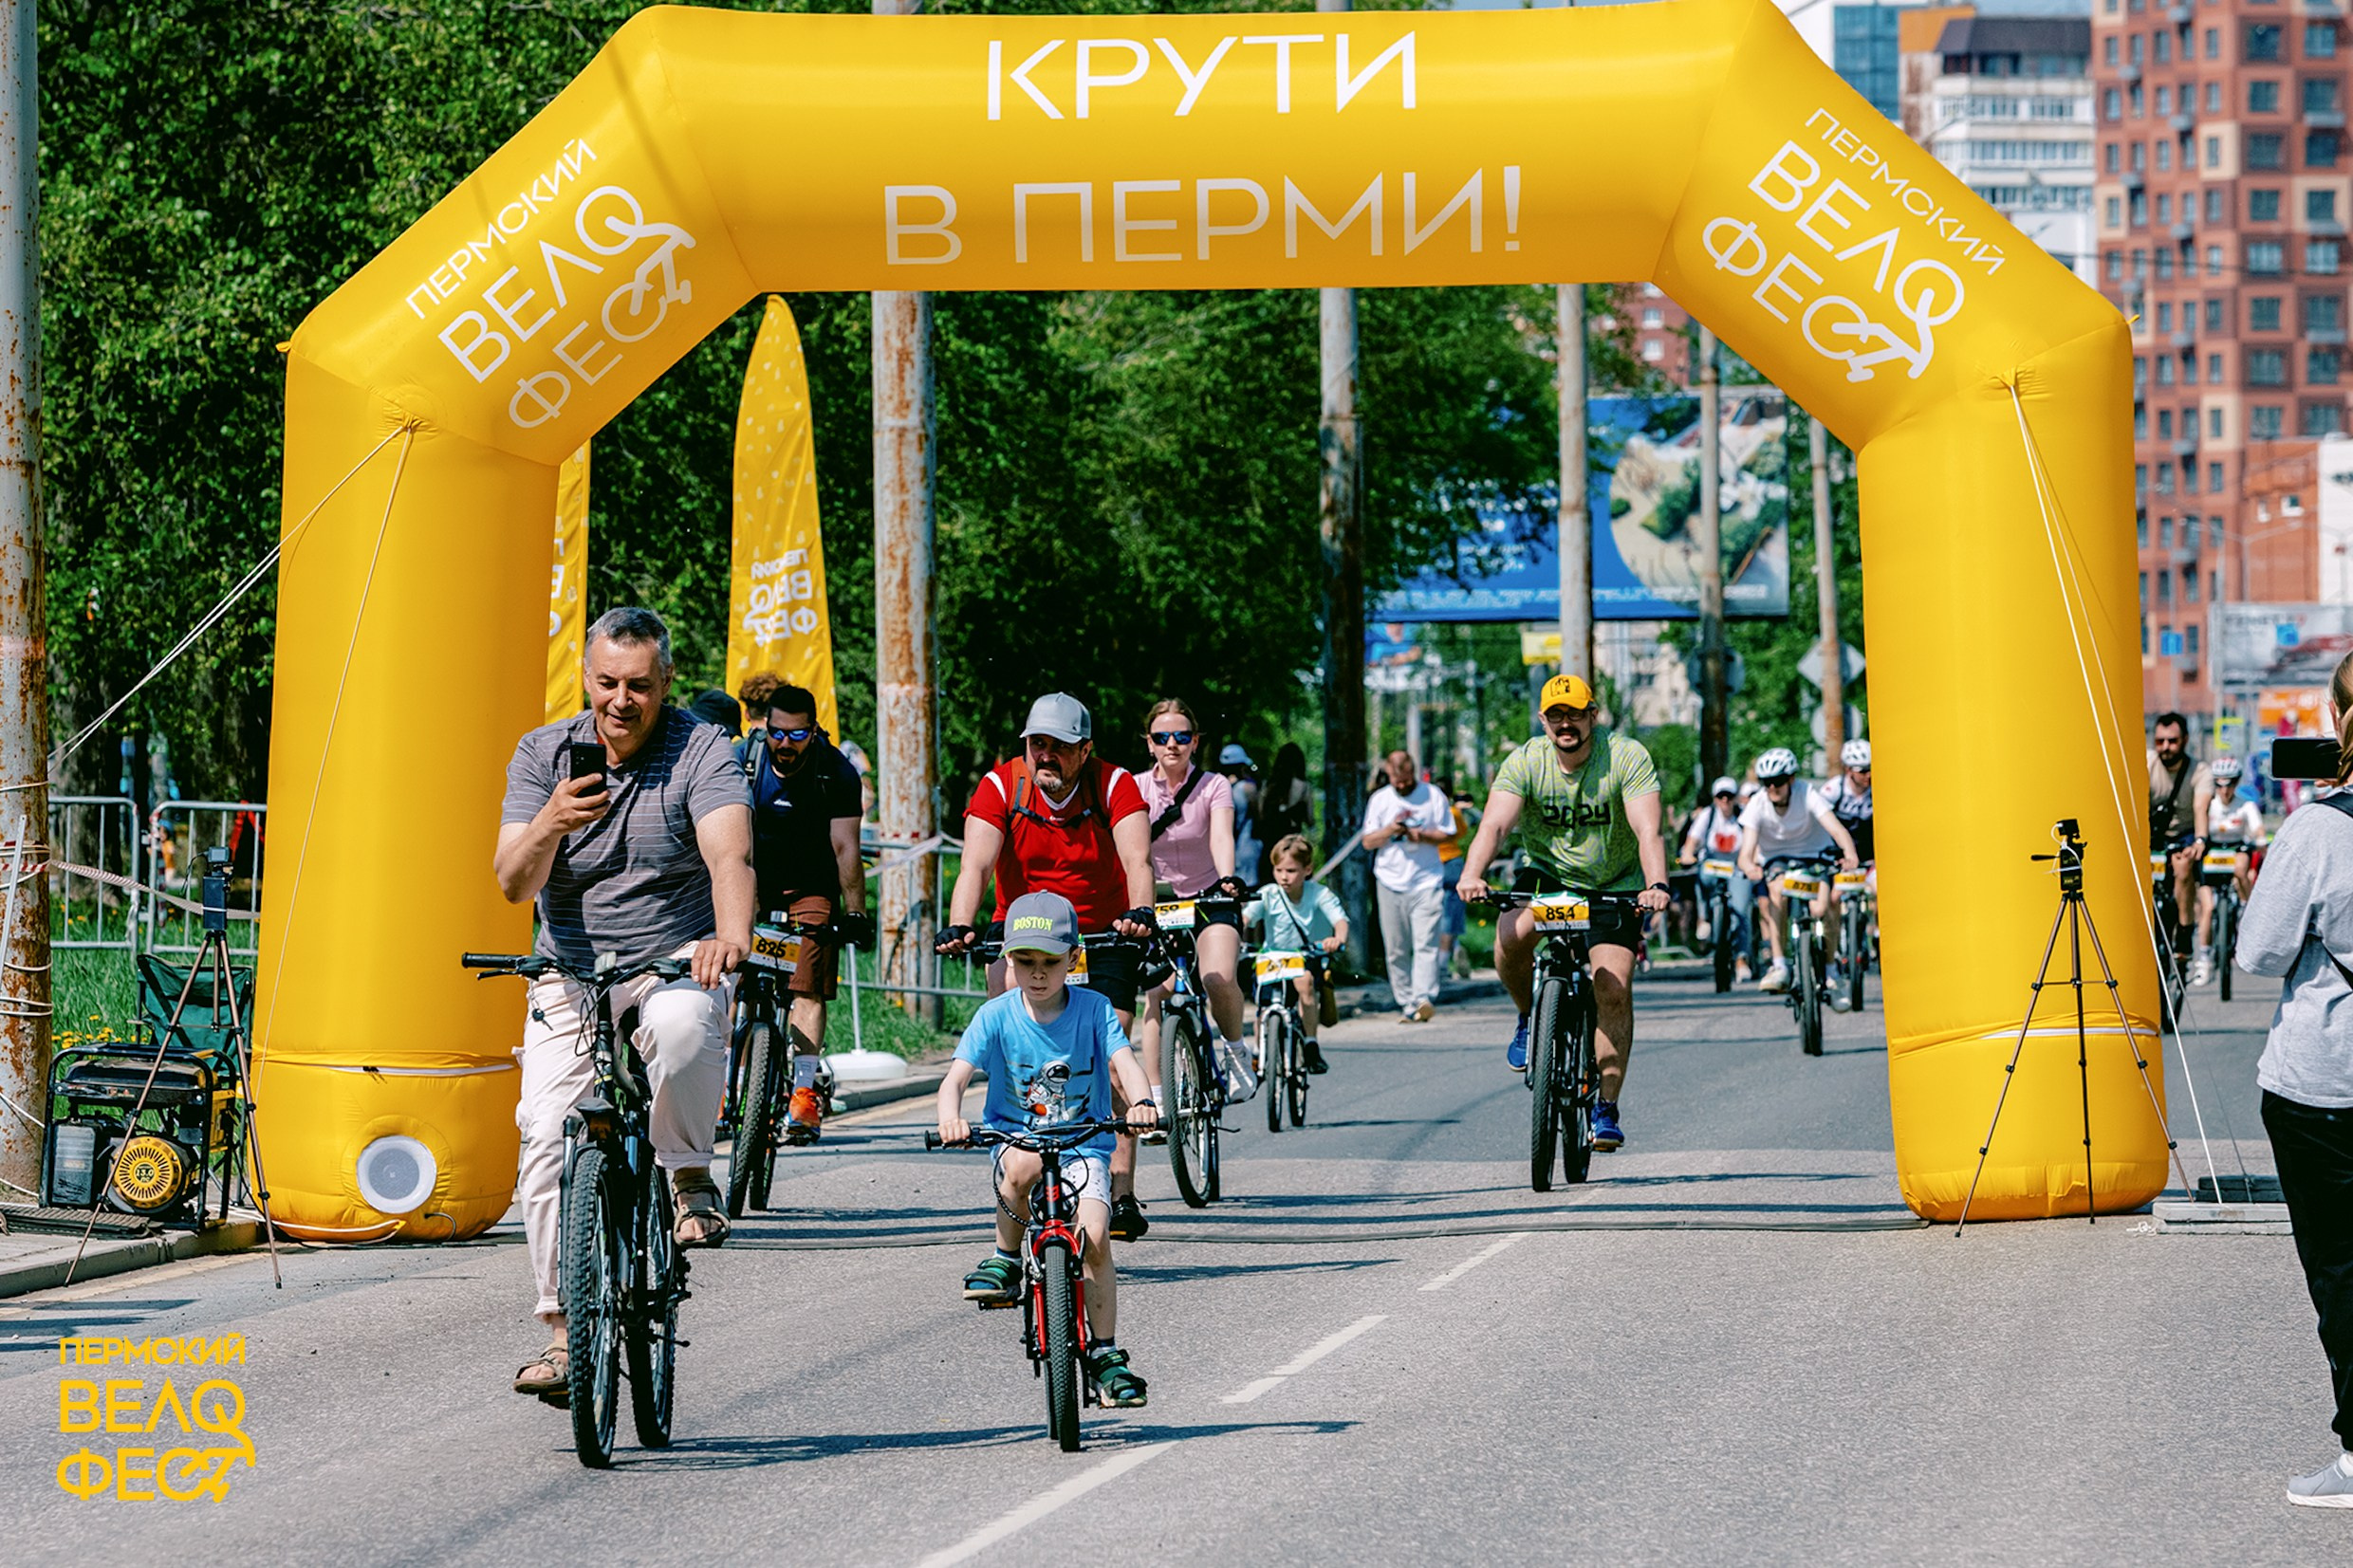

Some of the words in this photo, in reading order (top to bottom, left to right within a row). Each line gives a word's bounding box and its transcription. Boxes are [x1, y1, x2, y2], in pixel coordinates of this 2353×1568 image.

[987, 30, 1417, 120] КРУТИ
[405, 138, 598, 320] ПЕРМСКИЙ
[884, 184, 962, 265] В
[1013, 165, 1520, 263] ПЕРМИ!
[1805, 107, 2006, 275] ПЕРМСКИЙ
[755, 939, 787, 958] 825
[1013, 916, 1053, 932] BOSTON
[1546, 906, 1575, 920] 854
